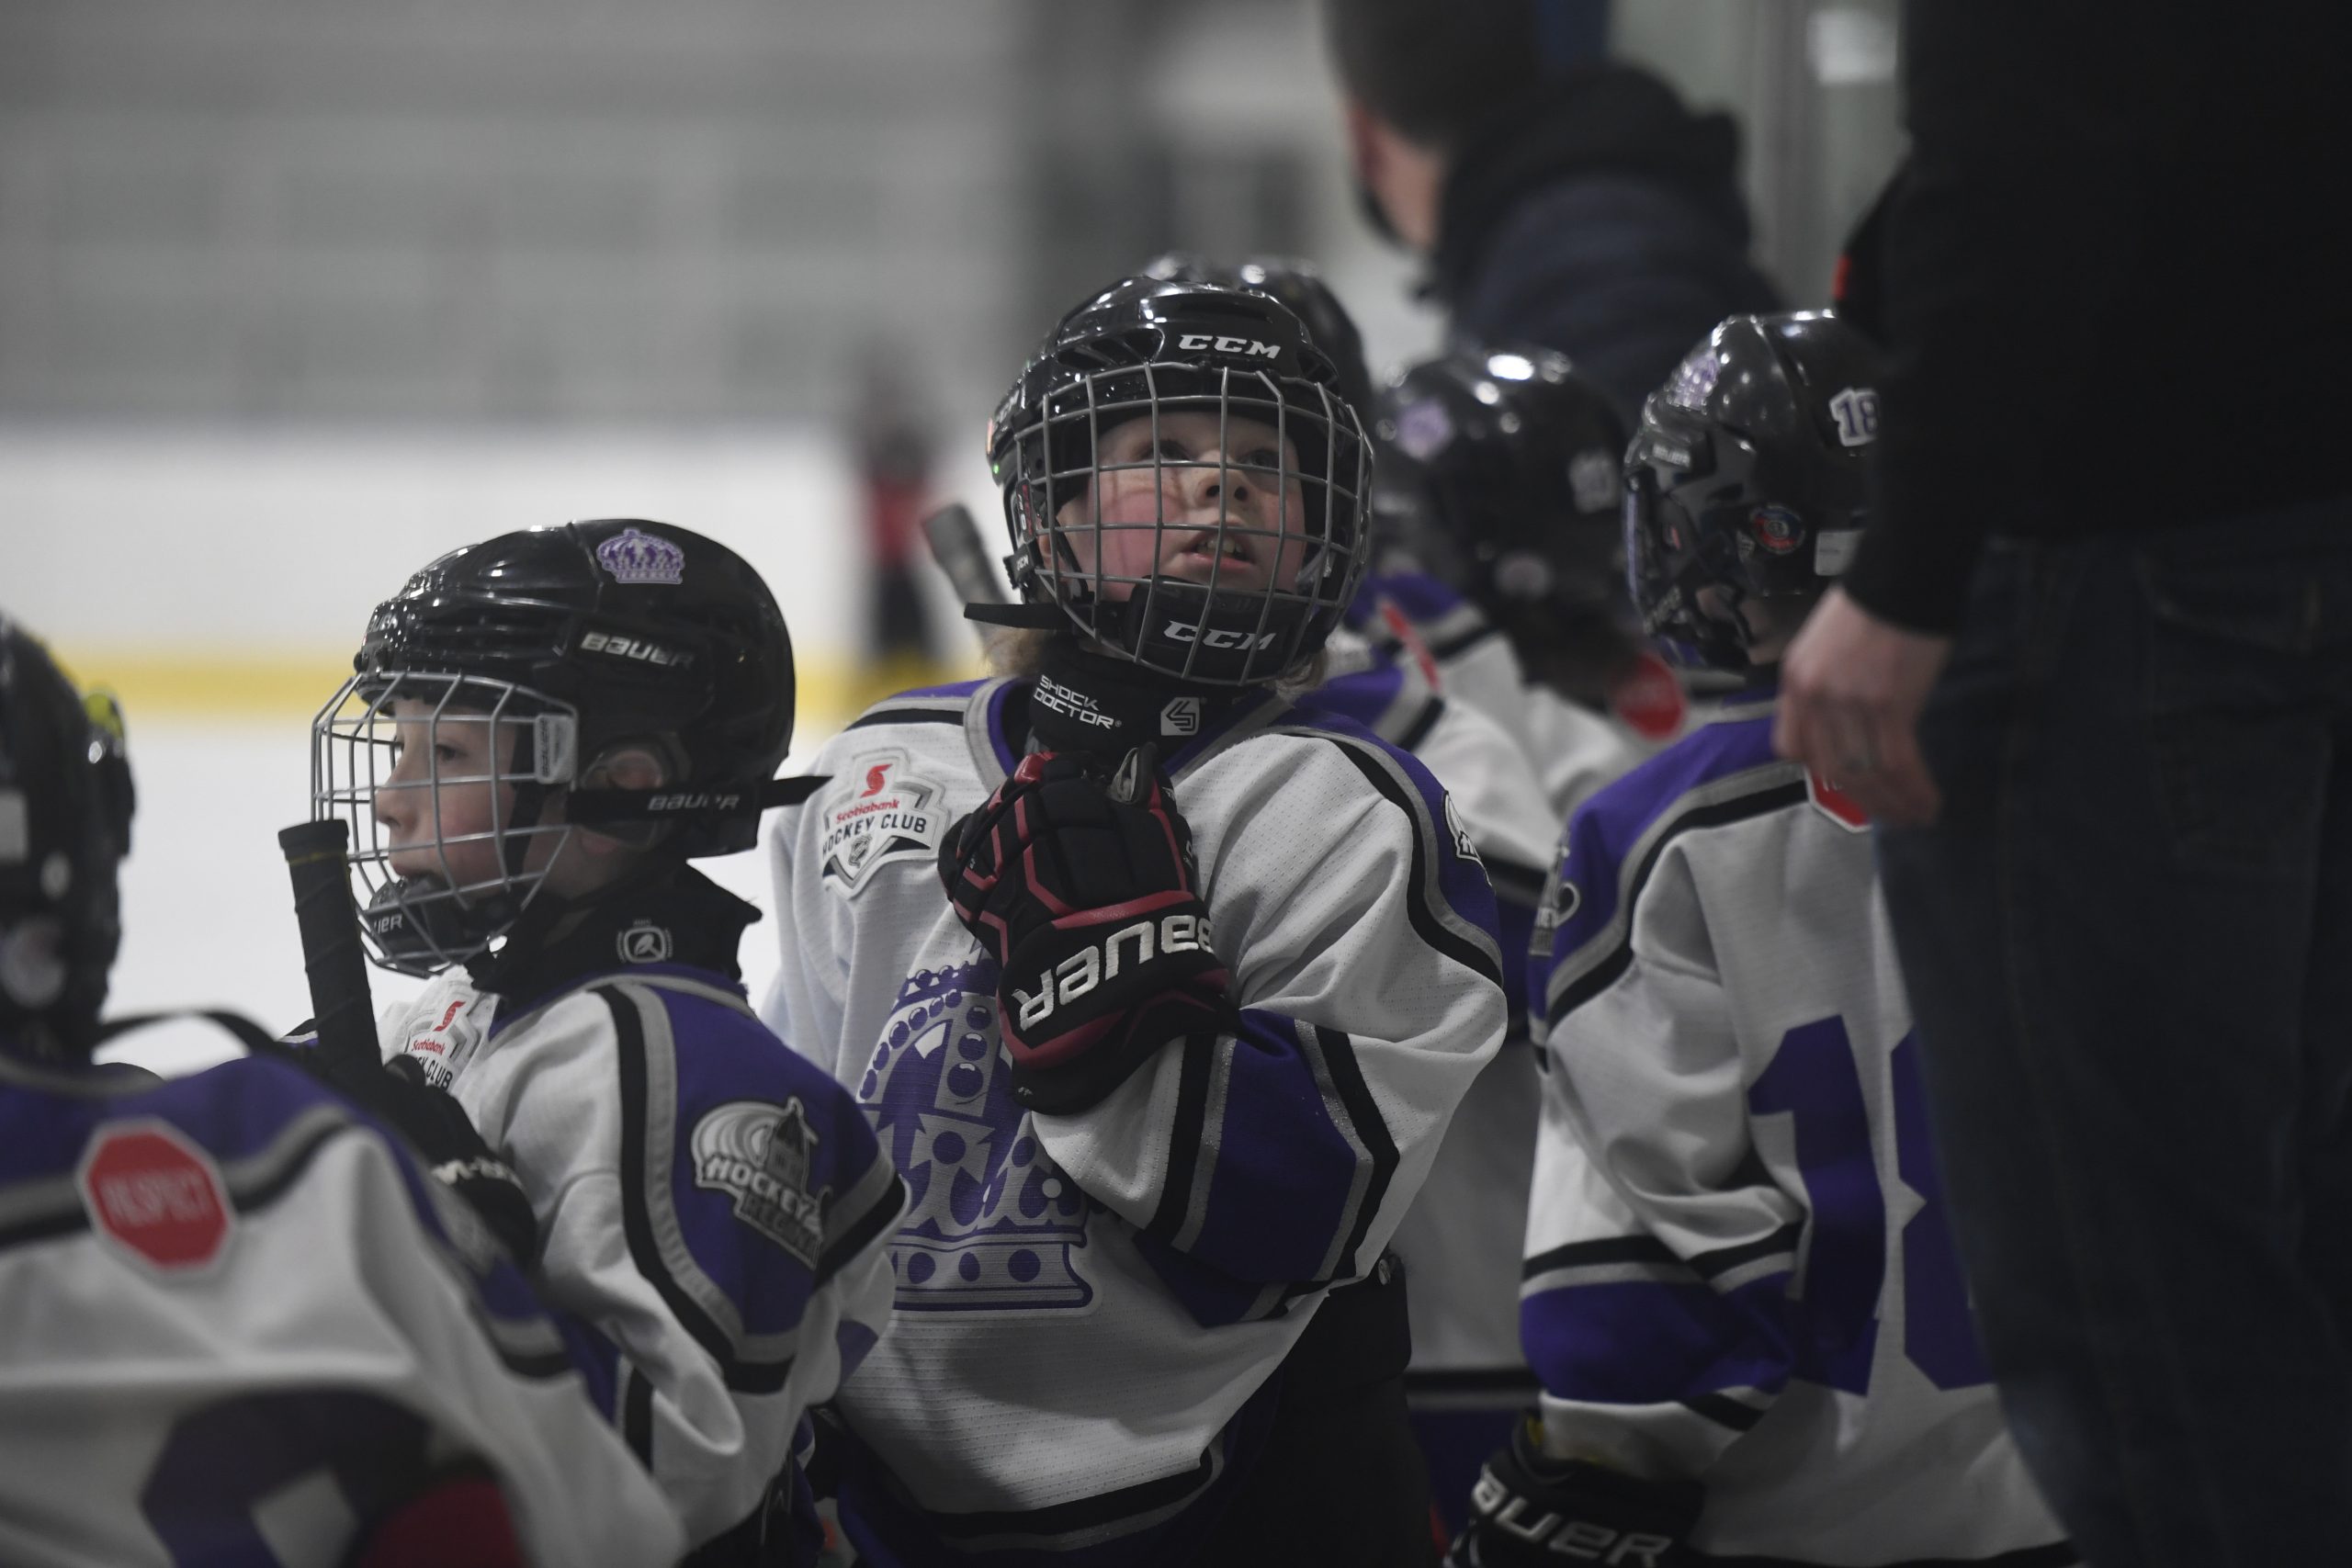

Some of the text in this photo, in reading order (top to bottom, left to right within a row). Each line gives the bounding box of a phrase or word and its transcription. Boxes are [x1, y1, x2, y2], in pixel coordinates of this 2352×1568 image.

[1179, 333, 1282, 359] CCM
[581, 630, 695, 670] BAUER
[1163, 620, 1276, 650] CCM
[1034, 687, 1114, 730] DOCTOR
[1039, 674, 1100, 712] SHOCK
[835, 798, 900, 825] Scotiabank
[822, 816, 875, 859] HOCKEY
[880, 813, 927, 834] CLUB
[1012, 915, 1214, 1032] BAUER
[425, 1059, 453, 1091] CLUB
[706, 1156, 809, 1220] HOCKEY
[1472, 1461, 1673, 1568] AUER
